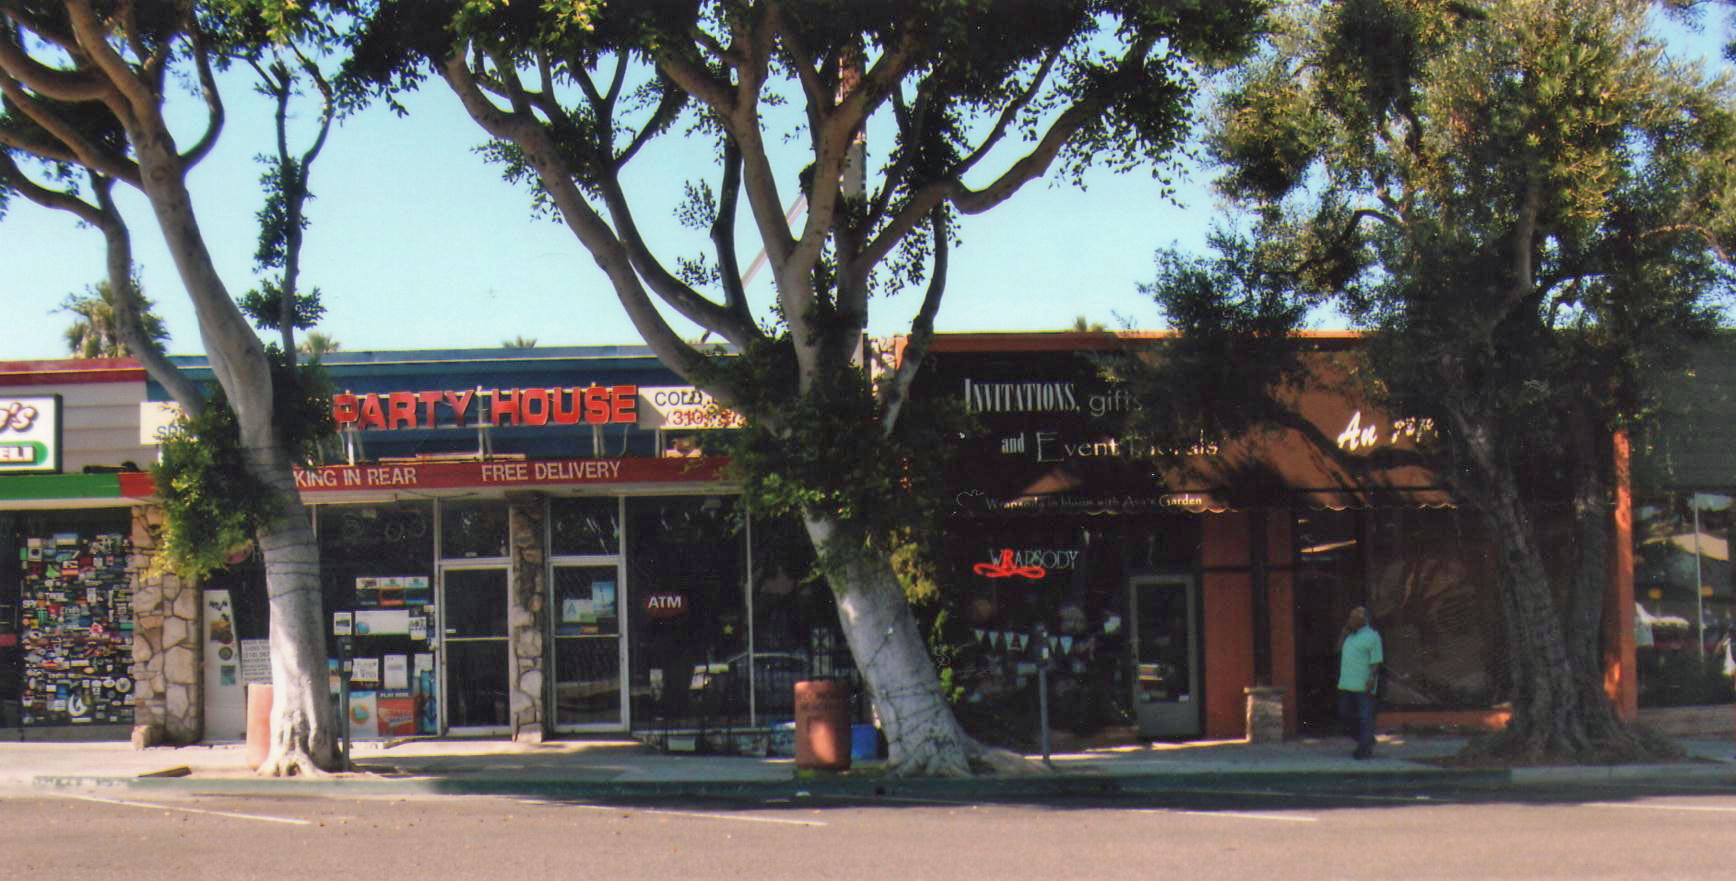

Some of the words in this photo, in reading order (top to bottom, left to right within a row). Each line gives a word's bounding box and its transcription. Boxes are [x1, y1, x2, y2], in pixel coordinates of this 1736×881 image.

[332, 389, 475, 430] PARTY
[491, 386, 637, 425] HOUSE
[655, 391, 702, 406] COLD
[1001, 433, 1025, 454] and
[1036, 431, 1120, 462] Event
[293, 470, 336, 488] KING
[343, 469, 360, 486] IN
[367, 467, 417, 486] REAR
[481, 464, 529, 482] FREE
[535, 461, 621, 480] DELIVERY
[1158, 493, 1203, 508] Garden
[648, 596, 682, 608] ATM
